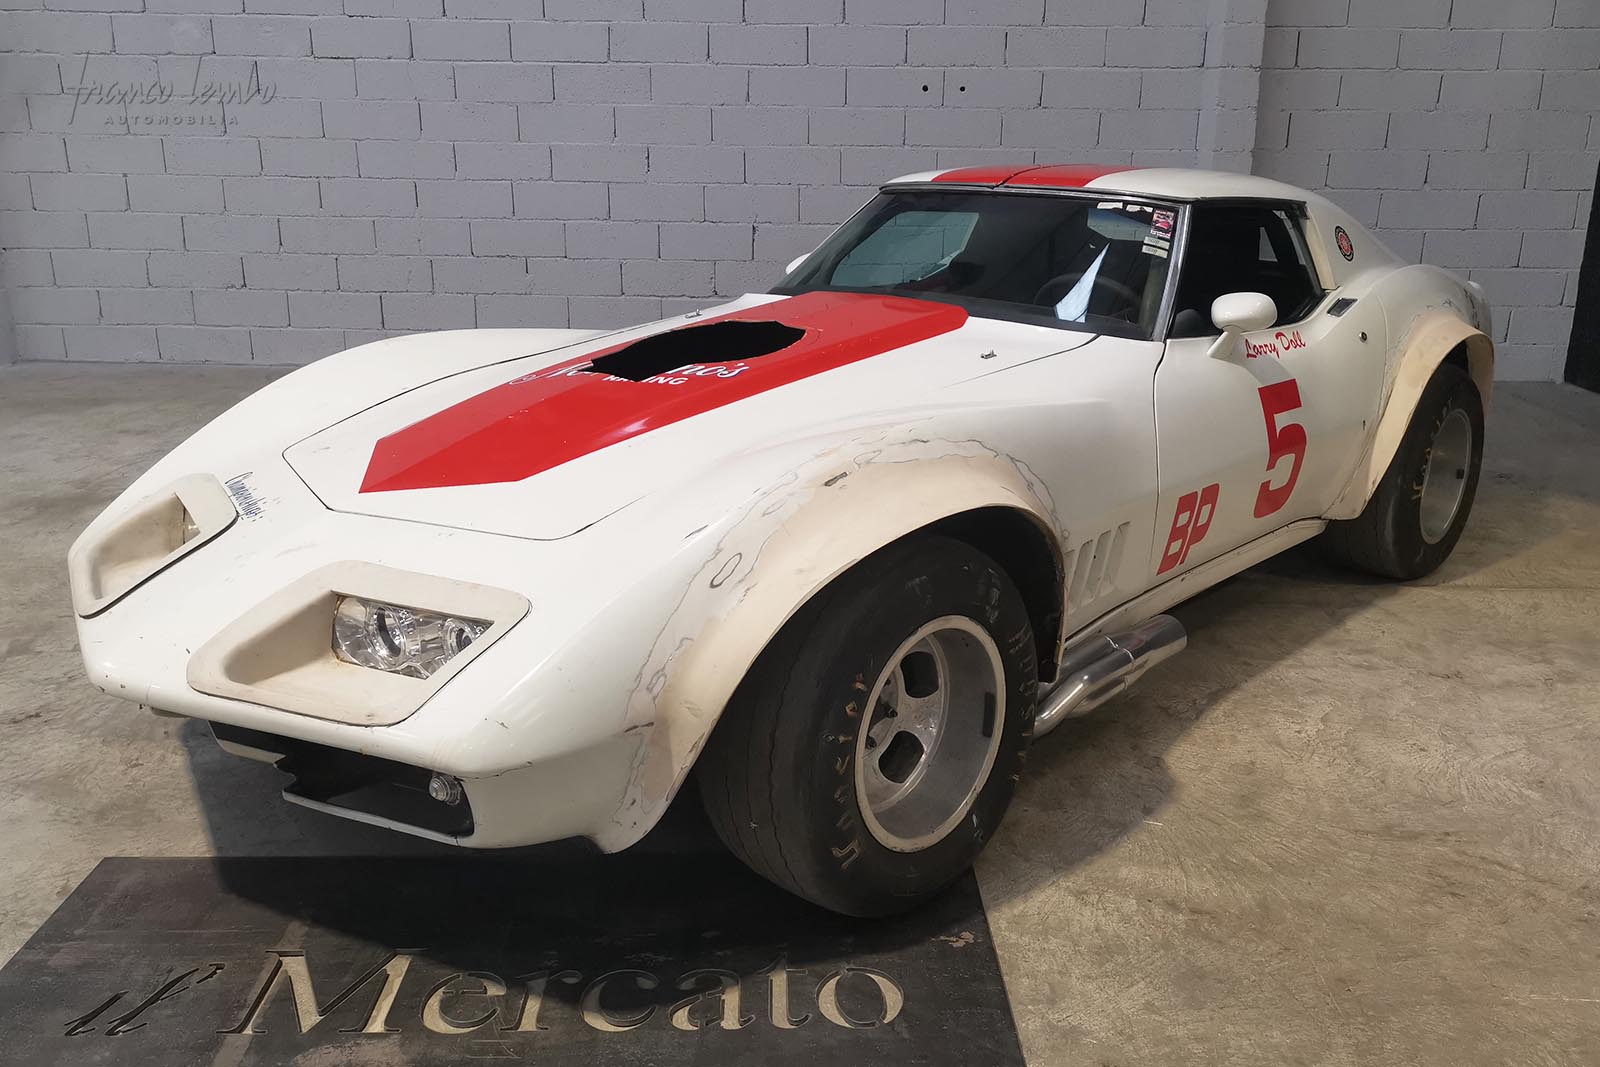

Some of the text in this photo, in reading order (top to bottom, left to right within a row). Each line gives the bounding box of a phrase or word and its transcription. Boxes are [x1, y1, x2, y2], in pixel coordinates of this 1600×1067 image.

[1245, 330, 1306, 359] Larry Doll
[1253, 378, 1307, 519] 5
[1156, 483, 1220, 576] BP
[215, 948, 905, 1035] Mercato
